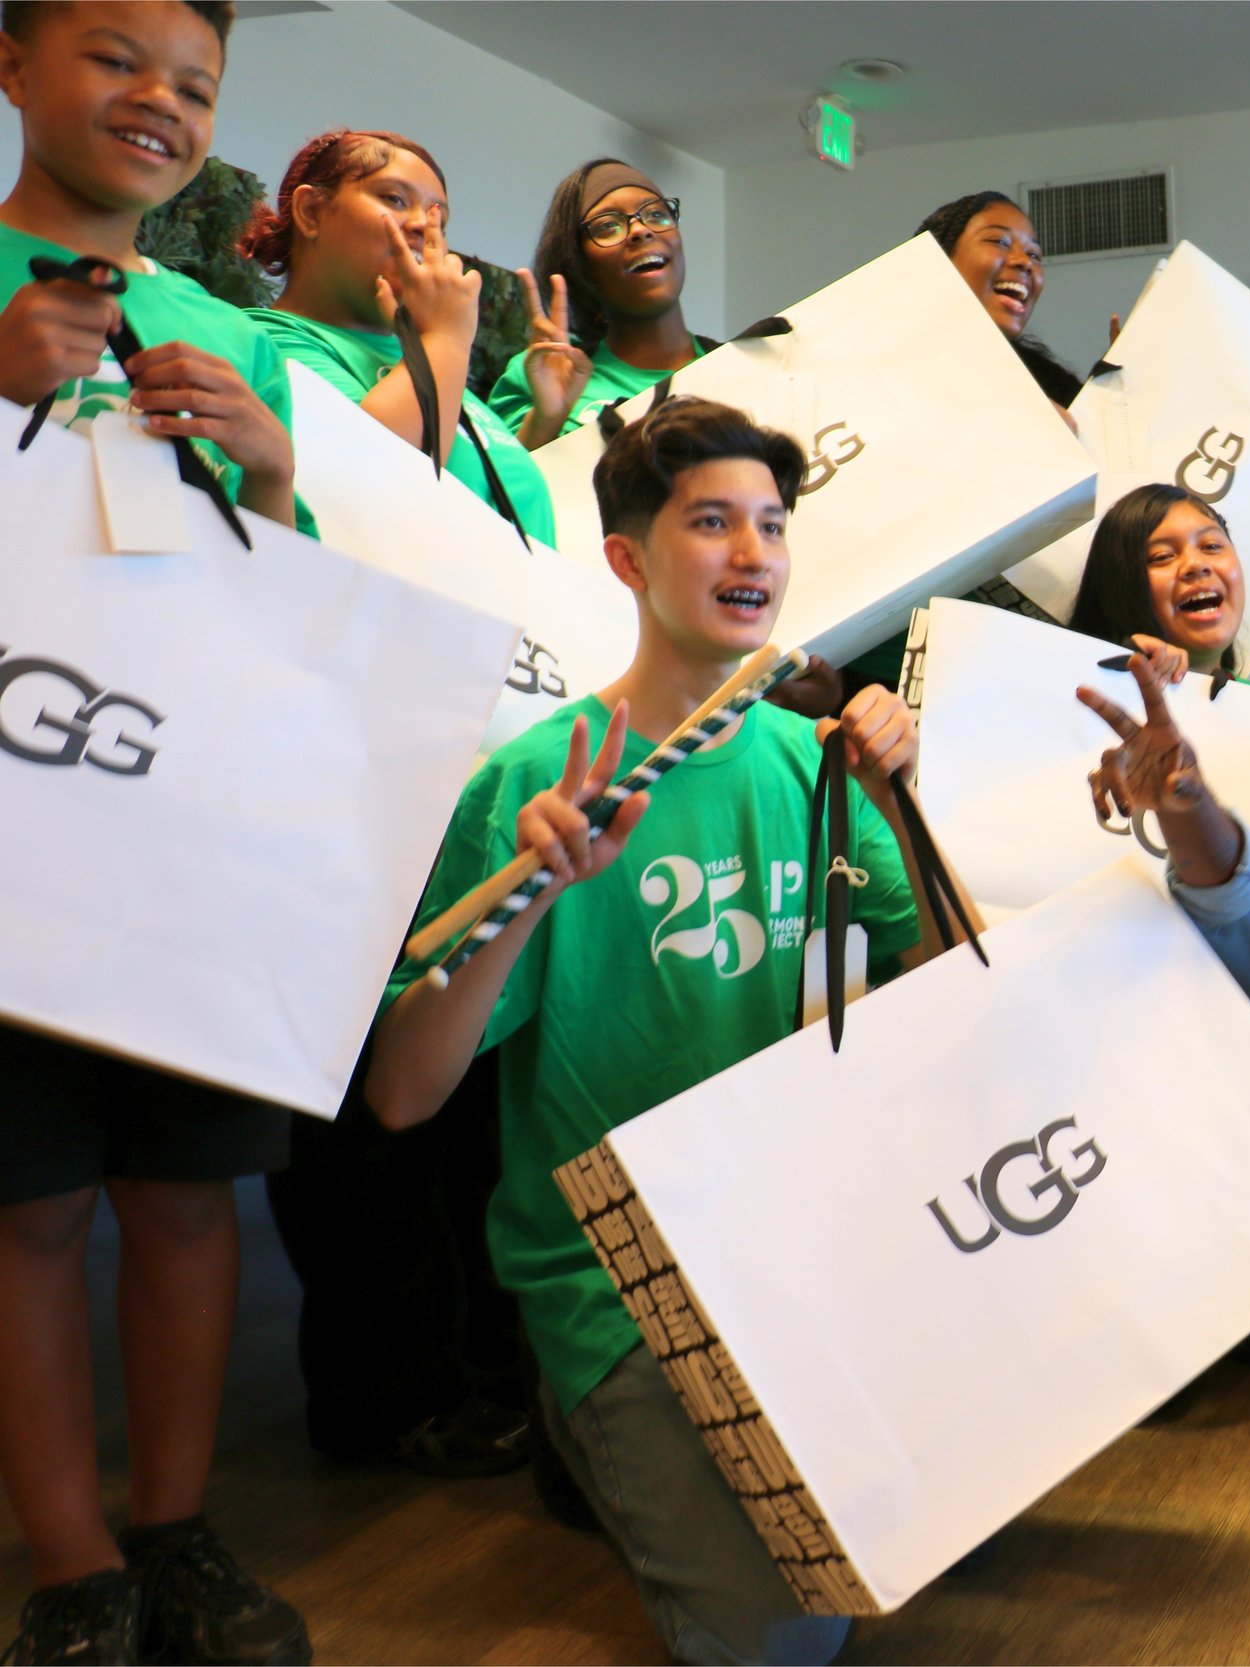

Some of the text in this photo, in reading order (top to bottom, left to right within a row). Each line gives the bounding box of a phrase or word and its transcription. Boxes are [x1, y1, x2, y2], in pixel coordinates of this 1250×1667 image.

[797, 421, 866, 497] GG
[1174, 425, 1244, 505] GG
[504, 637, 570, 699] GG
[0, 642, 168, 777] GG
[704, 855, 743, 876] YEARS
[639, 854, 766, 980] 25
[924, 1112, 1109, 1254] UGG
